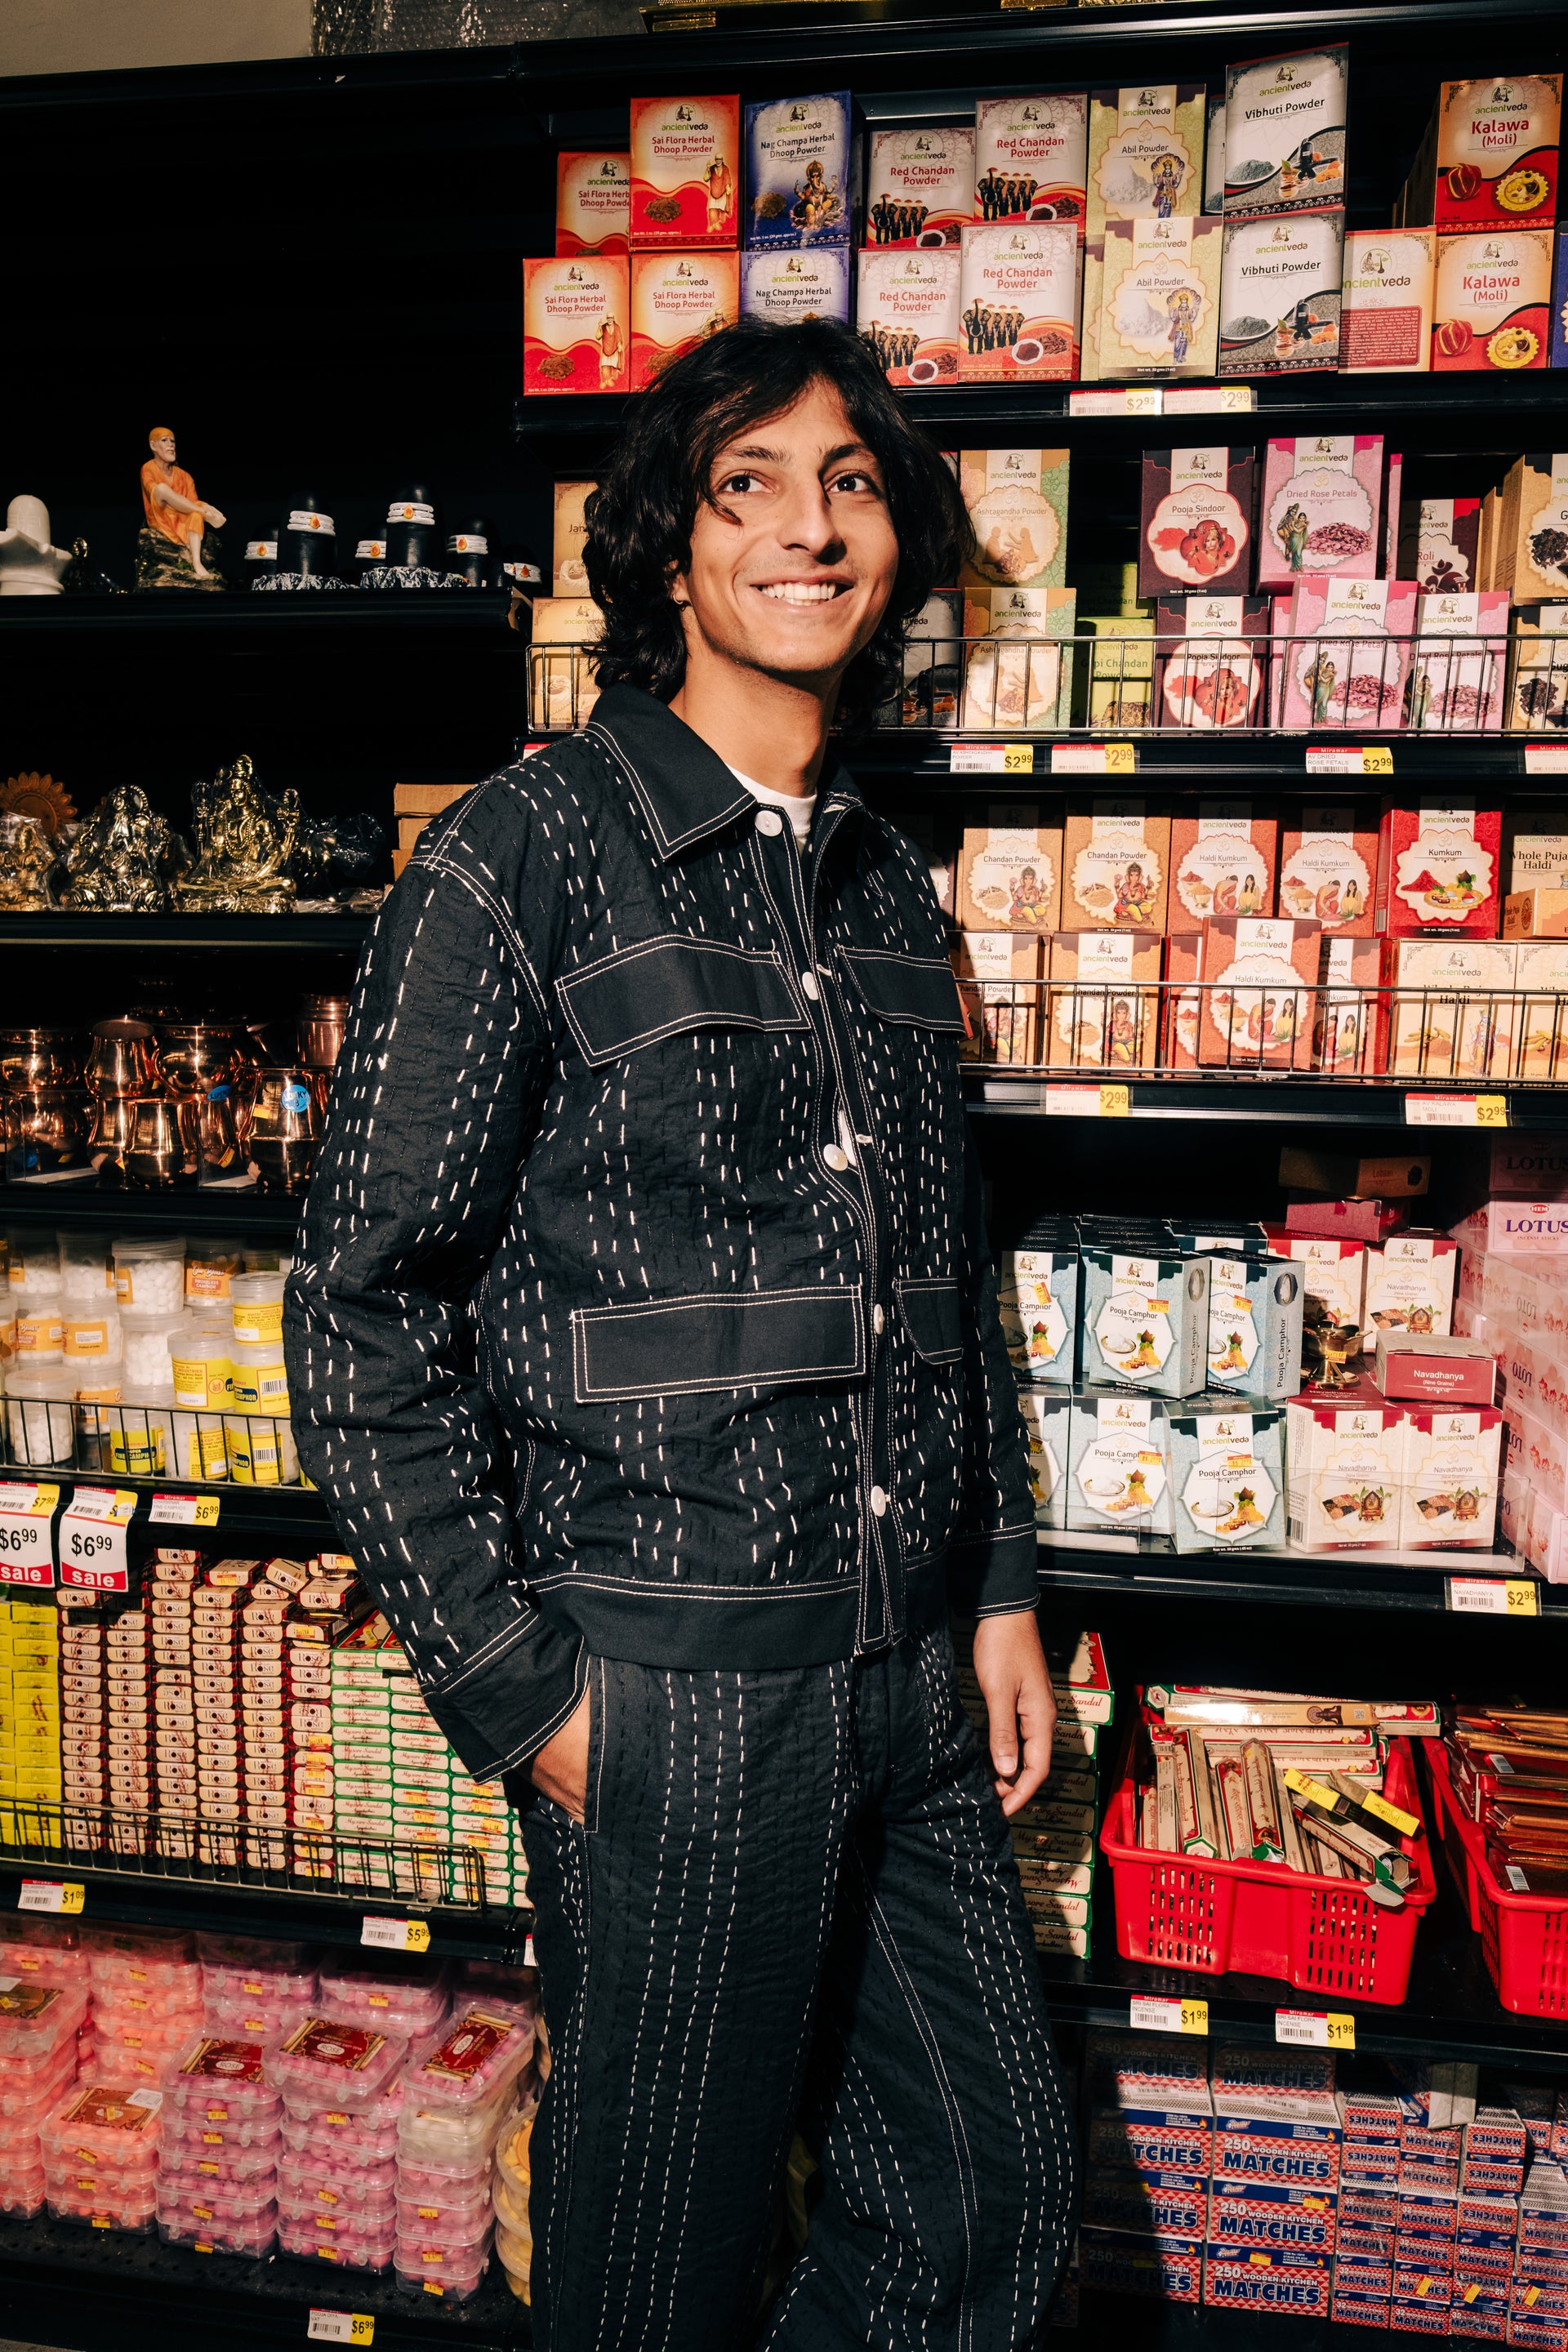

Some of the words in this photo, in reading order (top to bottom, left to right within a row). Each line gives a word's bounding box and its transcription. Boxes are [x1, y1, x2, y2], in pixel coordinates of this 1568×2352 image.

[1259, 79, 1312, 96] ancientveda
[1123, 107, 1170, 116] ancientveda
[1245, 105, 1282, 120] Vibhuti
[1285, 98, 1325, 113] Powder
[1475, 102, 1527, 114] ancientveda
[662, 122, 708, 131] ancientveda
[776, 121, 822, 134] ancientveda
[1007, 122, 1055, 131] ancientveda
[1472, 118, 1529, 135] Kalawa
[688, 136, 715, 144] Herbal
[761, 140, 774, 150] Nag
[777, 137, 807, 149] Champa
[810, 133, 835, 143] Herbal
[997, 139, 1016, 148] Red
[1019, 136, 1064, 147] Chandan
[1482, 133, 1517, 148] (Moli)
[654, 145, 679, 154] Dhoop
[683, 145, 712, 153] Powder
[770, 148, 795, 158] Dhoop
[797, 145, 826, 155] Powder
[1010, 147, 1049, 157] Powder
[1122, 145, 1137, 154] Abil
[1140, 144, 1169, 153] Powder
[1138, 240, 1187, 248] ancientveda
[1466, 259, 1518, 269] ancientveda
[1154, 277, 1184, 286] Powder
[1463, 274, 1520, 290] Kalawa
[1473, 289, 1508, 302] (Moli)
[1299, 453, 1348, 462] ancientveda
[991, 470, 1036, 479] ancientveda
[1176, 471, 1223, 479] ancientveda
[1333, 489, 1357, 497] Petals
[977, 507, 1019, 516] Ashtagandha
[1172, 506, 1192, 514] Pooja
[1417, 552, 1434, 561] Roli
[1331, 601, 1380, 610] ancientveda
[995, 609, 1041, 618] ancientveda
[1097, 819, 1140, 827] ancientveda
[983, 855, 1012, 863] Chandan
[1087, 852, 1116, 860] Chandan
[1523, 861, 1552, 870] Haldi
[1241, 940, 1287, 949] ancientveda
[1083, 955, 1128, 963] ancientveda
[1255, 976, 1286, 984] Kumkum
[1115, 1276, 1154, 1288] ancientveda
[1387, 1284, 1426, 1293] Navadhanya
[1110, 1306, 1126, 1316] Pooja
[1129, 1309, 1157, 1320] Camphor
[1278, 1317, 1286, 1356] Camphor
[1277, 1359, 1285, 1388] Pooja
[1414, 1370, 1464, 1382] Navadhanya
[1202, 1436, 1249, 1445] ancientveda
[1339, 1464, 1377, 1472] Navadhanya
[1434, 1466, 1472, 1474] Navadhanya
[1199, 1469, 1219, 1479] Pooja
[1222, 1468, 1256, 1479] Camphor
[1, 1566, 41, 1581] sale
[72, 1570, 114, 1587] sale
[1068, 1695, 1102, 1706] Sandal
[1459, 2255, 1508, 2268] MATCHES
[1215, 2266, 1241, 2278] 250
[1243, 2274, 1280, 2283] WOODEN
[1281, 2278, 1317, 2286] KITCHEN
[1339, 2275, 1387, 2287] MATCHES
[1214, 2279, 1320, 2305] MATCHES
